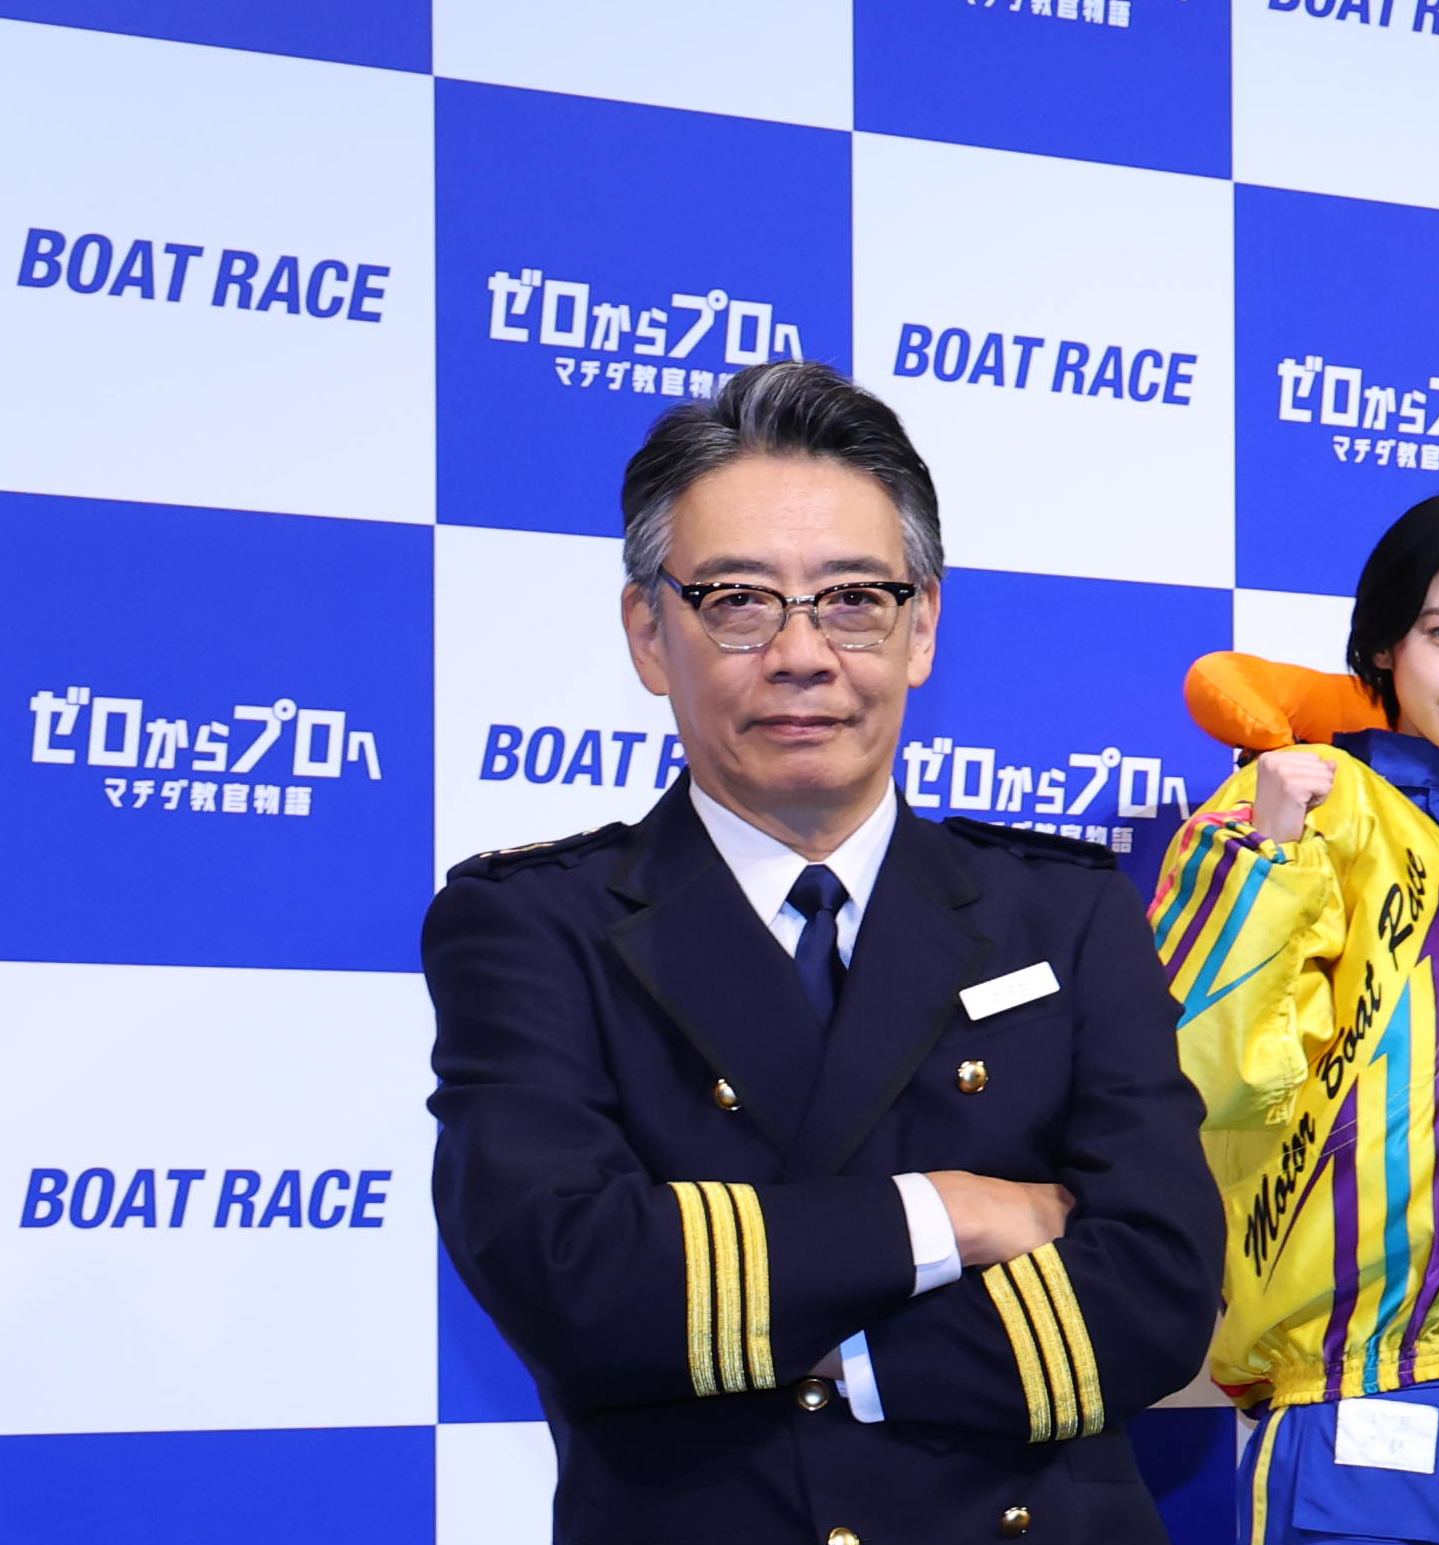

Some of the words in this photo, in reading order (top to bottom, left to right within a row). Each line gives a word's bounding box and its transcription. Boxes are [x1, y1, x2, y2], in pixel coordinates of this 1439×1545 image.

[17, 228, 204, 302] BOAT
[211, 249, 390, 323] RACE
[489, 269, 803, 365] ゼロからプロへ
[893, 323, 1044, 389] BOAT
[1051, 341, 1197, 405] RACE
[30, 687, 381, 779] ゼロからプロへ
[479, 724, 647, 788] BOAT
[105, 779, 311, 815] マチダ教官物語
[902, 737, 1190, 820] ゼロからプロへ
[1315, 960, 1382, 1100] Boat
[19, 1168, 206, 1229] BOAT
[214, 1169, 392, 1229] RACE
